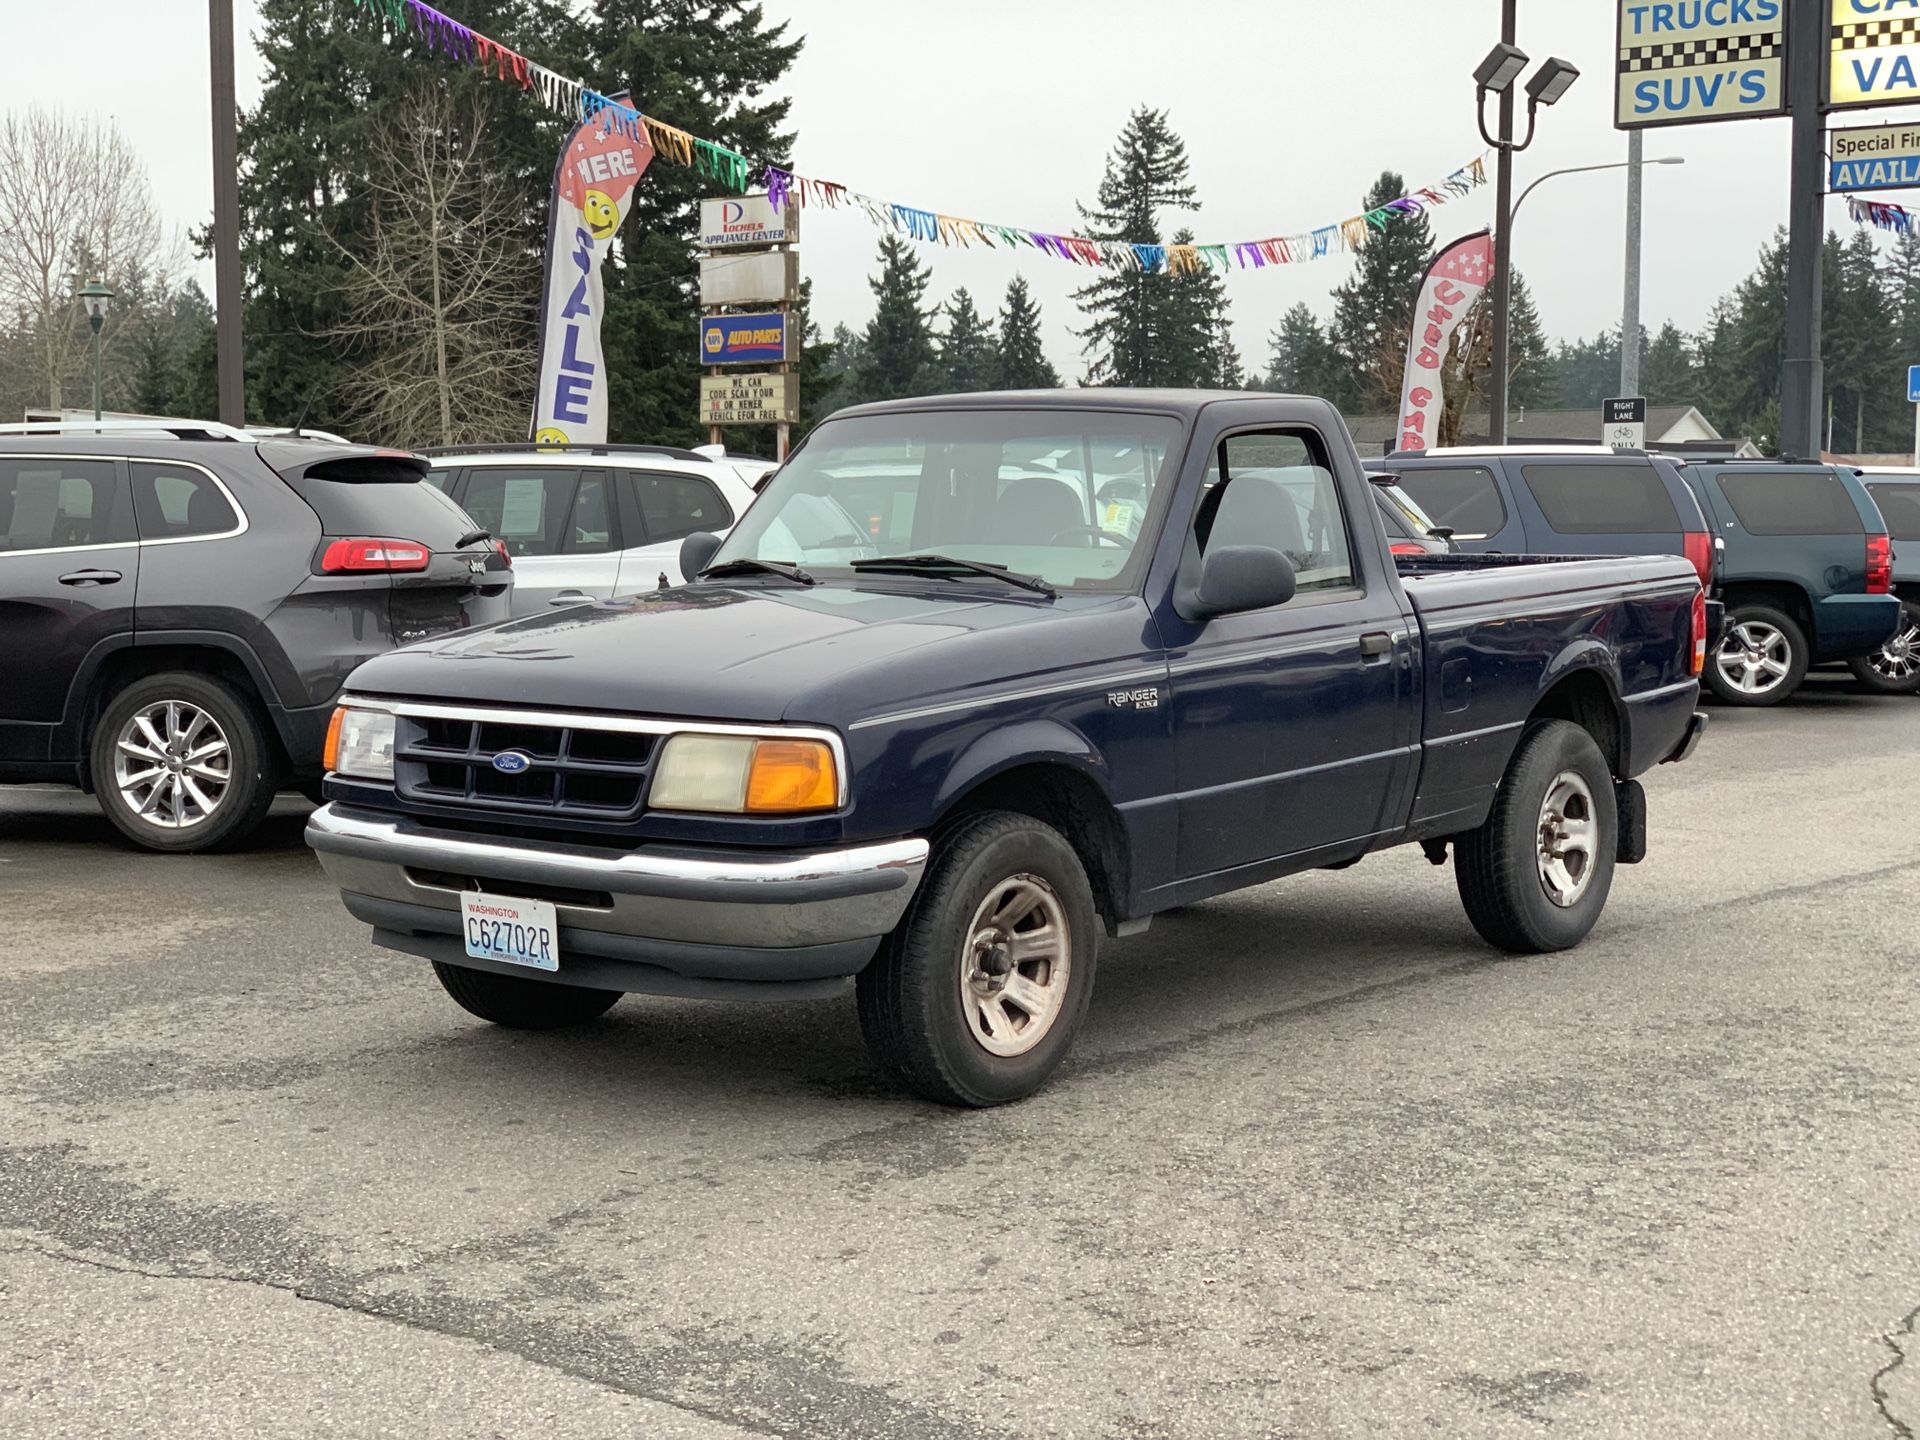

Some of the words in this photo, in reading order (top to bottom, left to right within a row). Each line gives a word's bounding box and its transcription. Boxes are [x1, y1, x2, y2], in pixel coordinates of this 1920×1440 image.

[1627, 0, 1779, 34] TRUCKS
[1634, 70, 1766, 113] SUV'S
[1836, 134, 1895, 156] Special
[577, 148, 637, 184] HERE
[704, 232, 750, 245] APPLIANCE
[752, 229, 784, 241] CENTER
[553, 227, 595, 424] SALE
[1416, 280, 1466, 369] USED
[728, 330, 752, 345] AUTO
[753, 328, 782, 343] PARTS
[733, 378, 743, 387] WE
[748, 377, 762, 387] CAN
[709, 389, 727, 399] CODE
[731, 389, 749, 399] SCAN
[724, 401, 733, 409] OR
[739, 399, 763, 409] NEWER
[1613, 402, 1634, 410] RIGHT
[760, 409, 777, 419] FREE
[1614, 412, 1633, 420] LANE
[500, 755, 520, 768] Ford
[468, 904, 519, 919] WASHINGTON
[468, 917, 551, 960] C62702R
